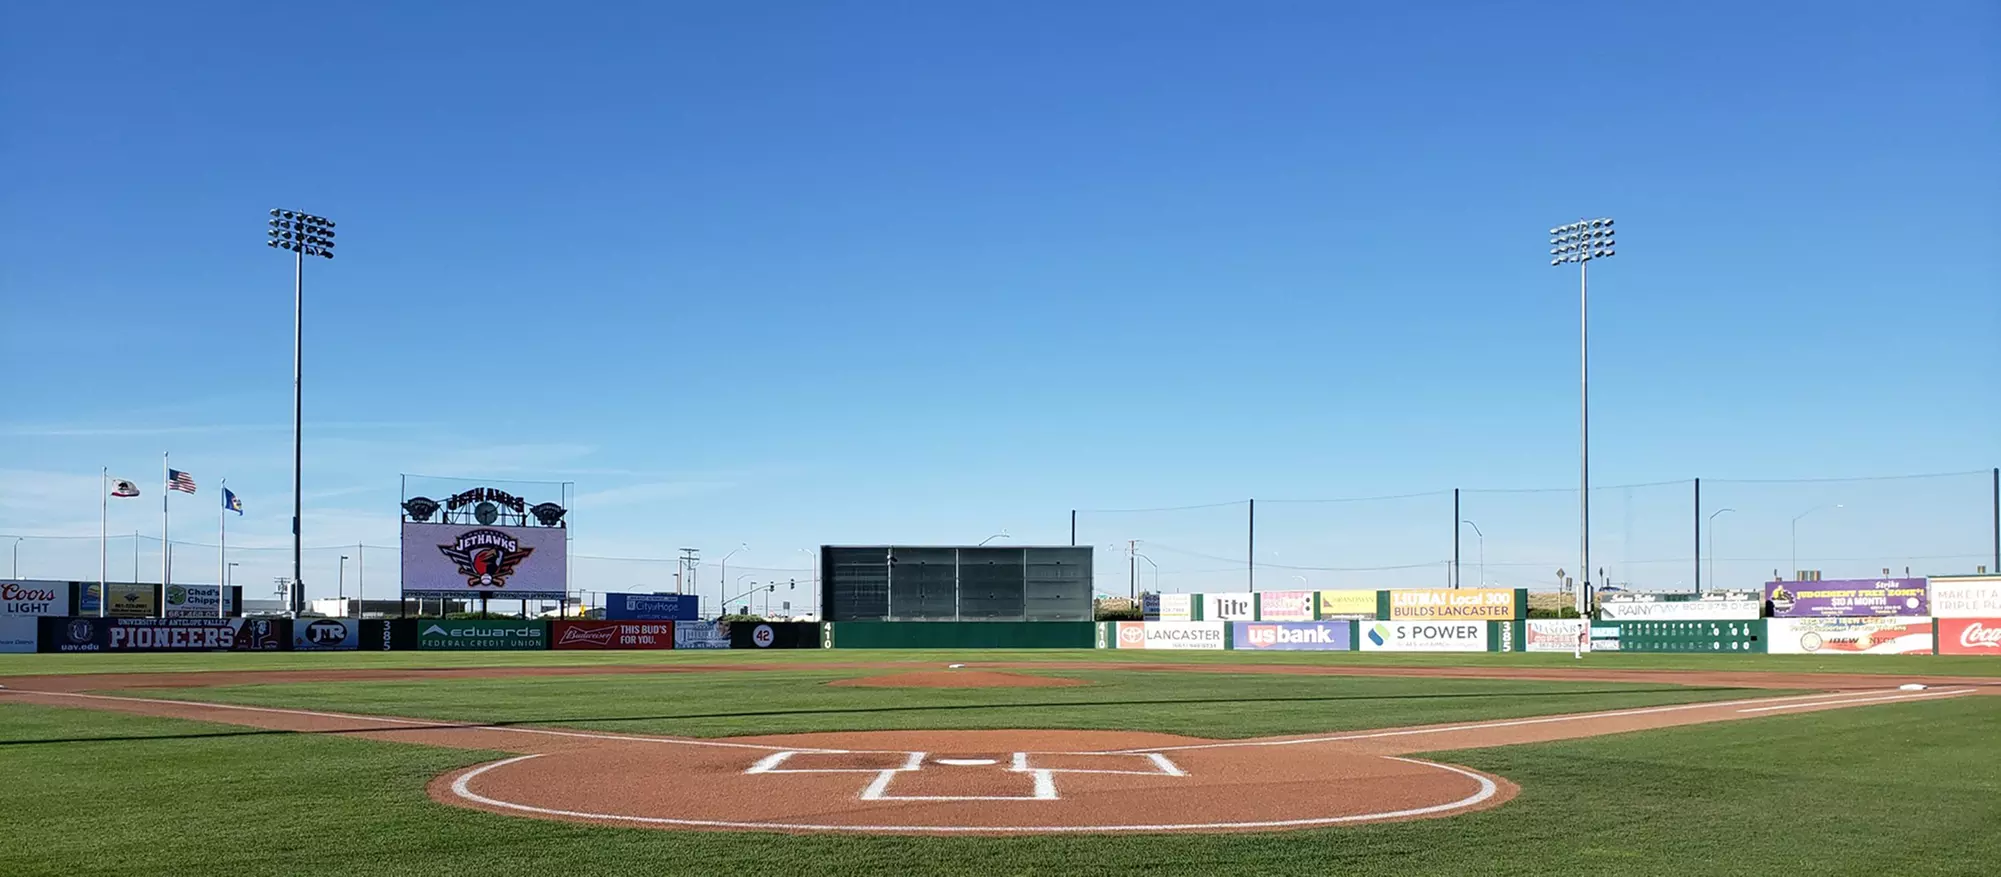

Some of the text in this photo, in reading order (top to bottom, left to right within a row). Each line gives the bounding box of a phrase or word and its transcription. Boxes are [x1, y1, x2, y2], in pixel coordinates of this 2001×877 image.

[456, 534, 516, 553] JETHAWKS
[1, 584, 56, 601] Coors
[1938, 589, 1998, 599] MAKE IT A
[1450, 592, 1483, 605] Local
[1485, 592, 1510, 605] 300
[1854, 597, 1887, 606] MONTH
[7, 603, 49, 613] LIGHT
[1216, 598, 1248, 619] Lite
[1939, 600, 2001, 610] TRIPLE PL
[1394, 606, 1509, 616] BUILDS LANCASTER
[450, 627, 541, 637] edwards
[620, 625, 667, 634] THIS BUD'S
[1397, 626, 1478, 639] S POWER
[109, 627, 235, 648] PIONEERS
[565, 629, 612, 641] Budweiser
[620, 635, 656, 645] FOR YOU.
[755, 630, 770, 641] 42
[1146, 629, 1220, 641] LANCASTER
[60, 643, 99, 651] uav.edu
[422, 639, 541, 647] FEDERAL CREDIT UNION
